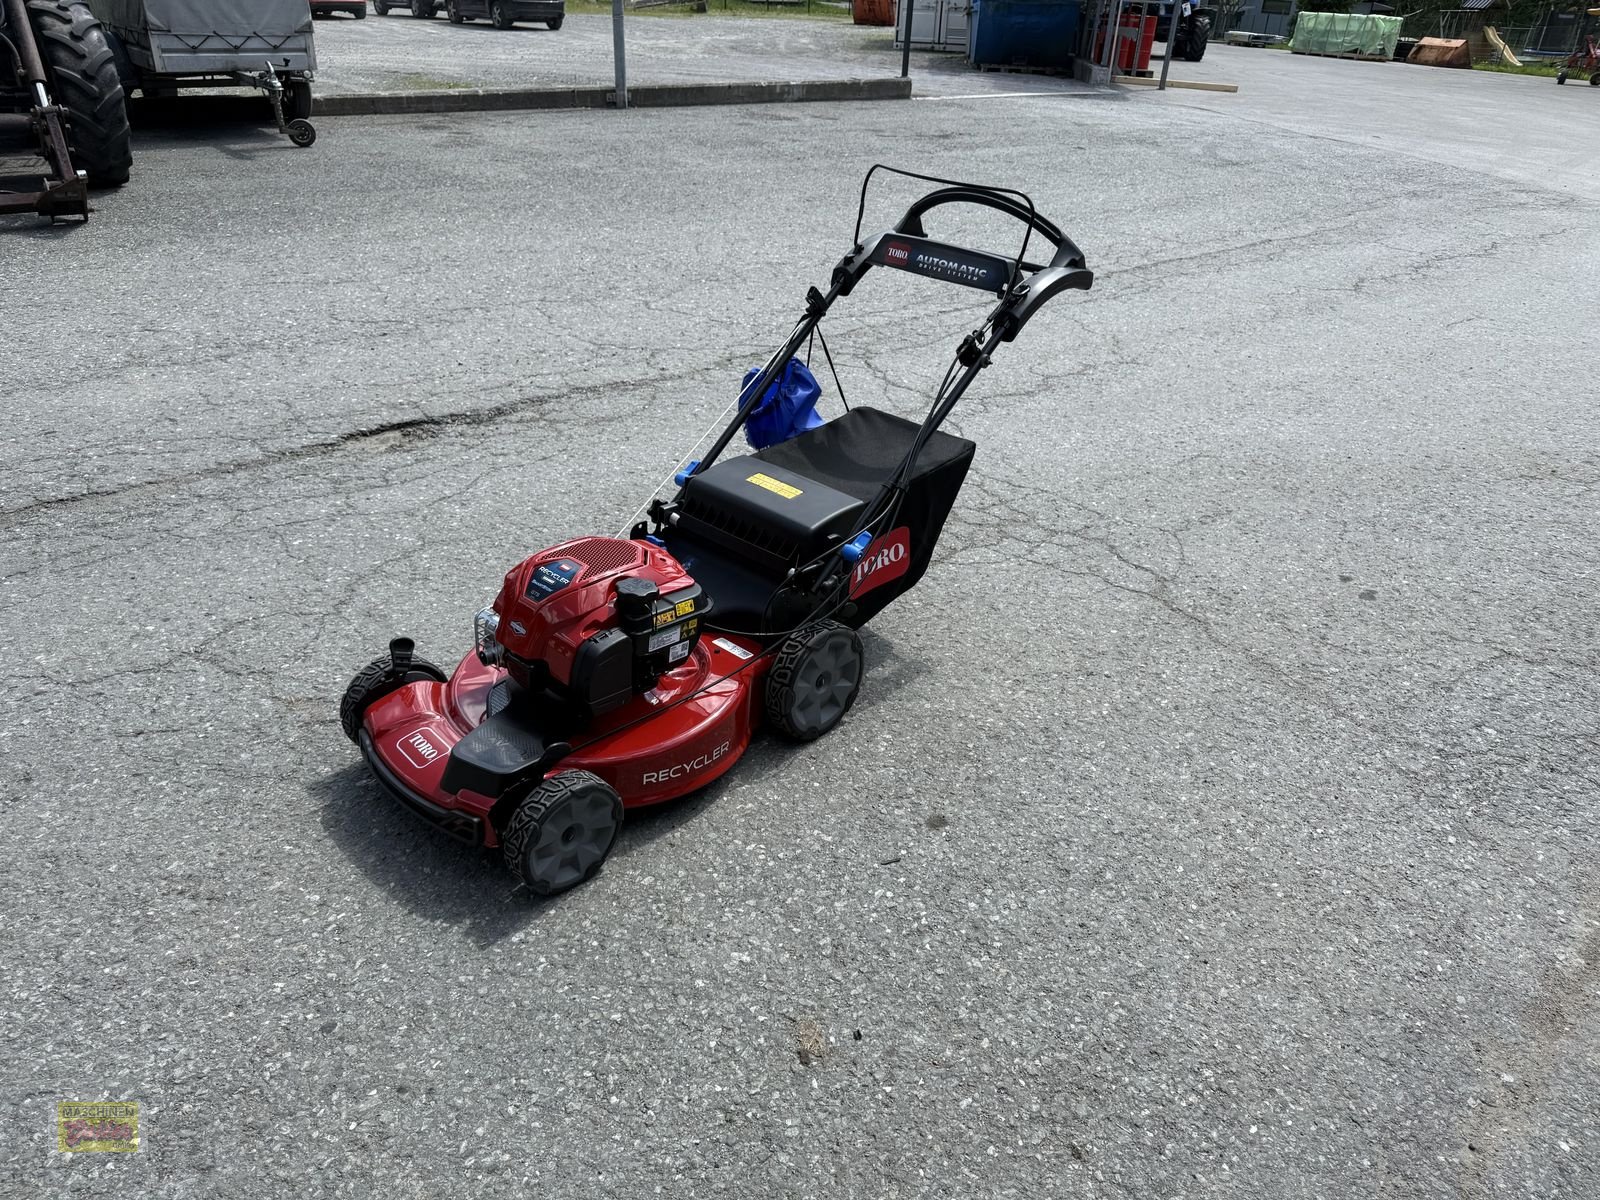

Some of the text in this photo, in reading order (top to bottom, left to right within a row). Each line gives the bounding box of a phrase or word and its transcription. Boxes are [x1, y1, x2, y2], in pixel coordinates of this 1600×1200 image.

[888, 247, 908, 259] TORO
[916, 254, 988, 277] AUTOMATIC
[918, 263, 942, 272] DRIVE
[539, 566, 571, 584] RECYCLER
[409, 732, 438, 759] TORO
[643, 740, 730, 785] RECYCLER
